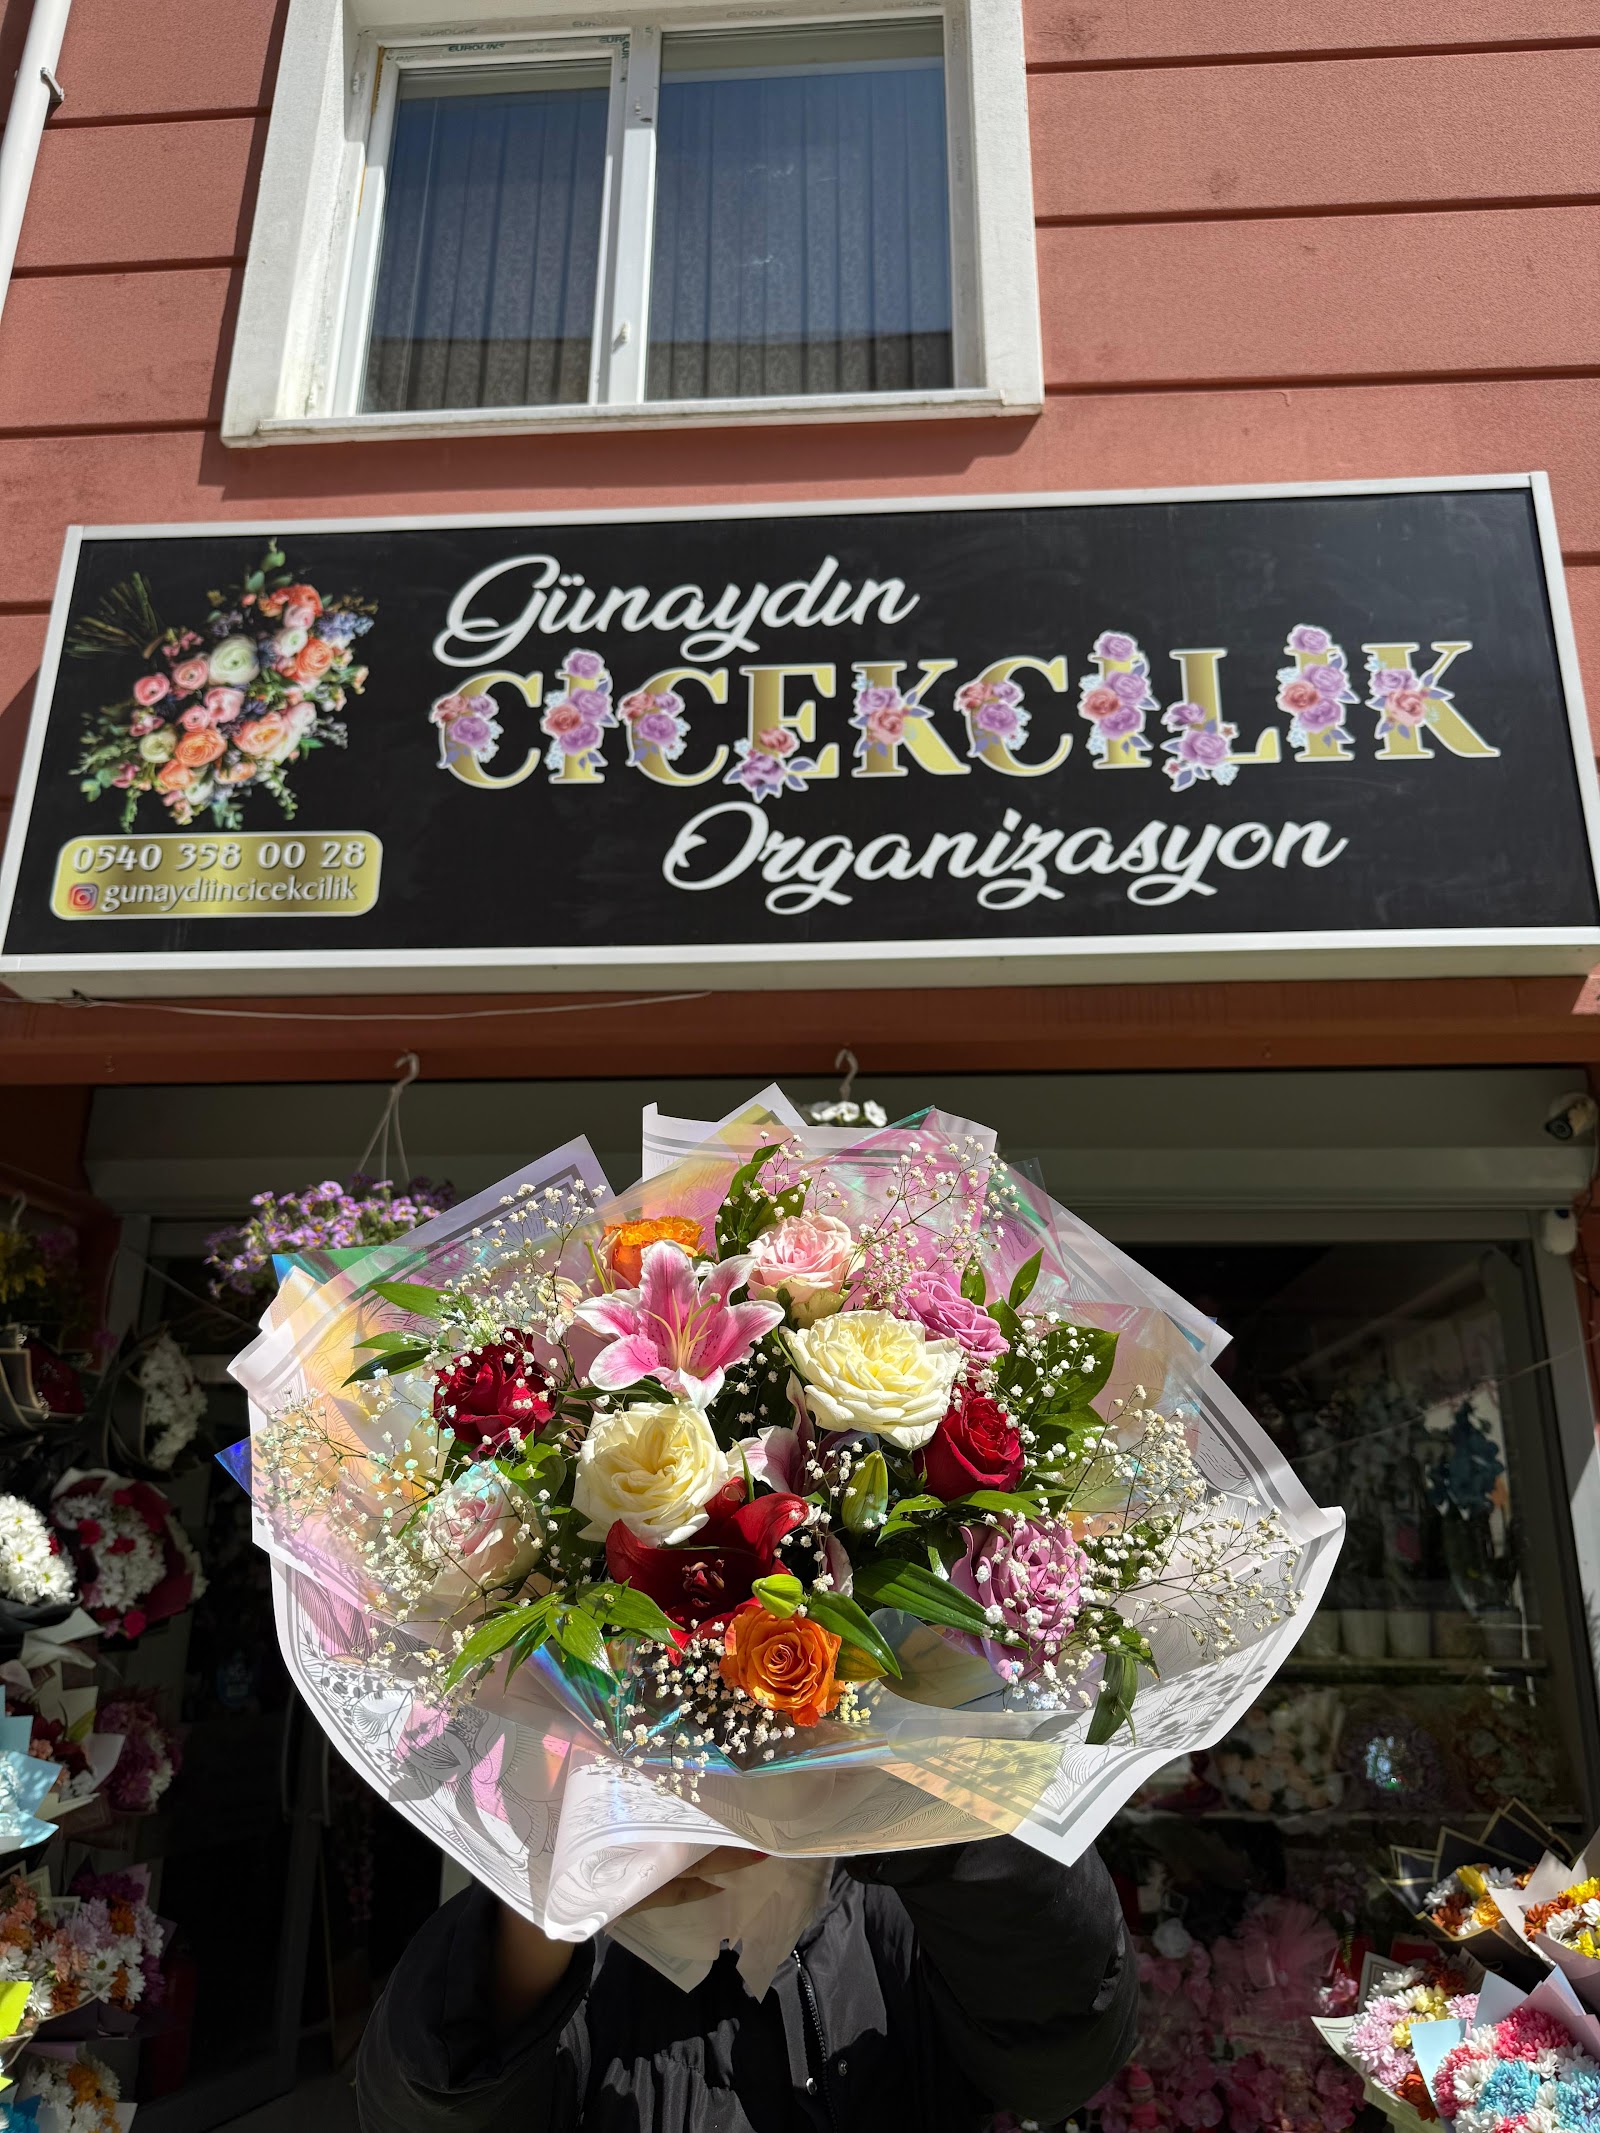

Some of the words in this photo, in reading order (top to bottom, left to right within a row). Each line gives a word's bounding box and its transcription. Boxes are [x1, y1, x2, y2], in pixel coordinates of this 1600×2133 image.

[448, 42, 506, 53] EUROLINE
[433, 554, 920, 668] Günaydın
[72, 843, 163, 873] 0540
[175, 842, 242, 871] 358
[258, 840, 307, 869] 00
[320, 841, 367, 868] 28
[662, 800, 1350, 915] Organizasyon
[101, 874, 358, 912] gunaydiincicekcilik
